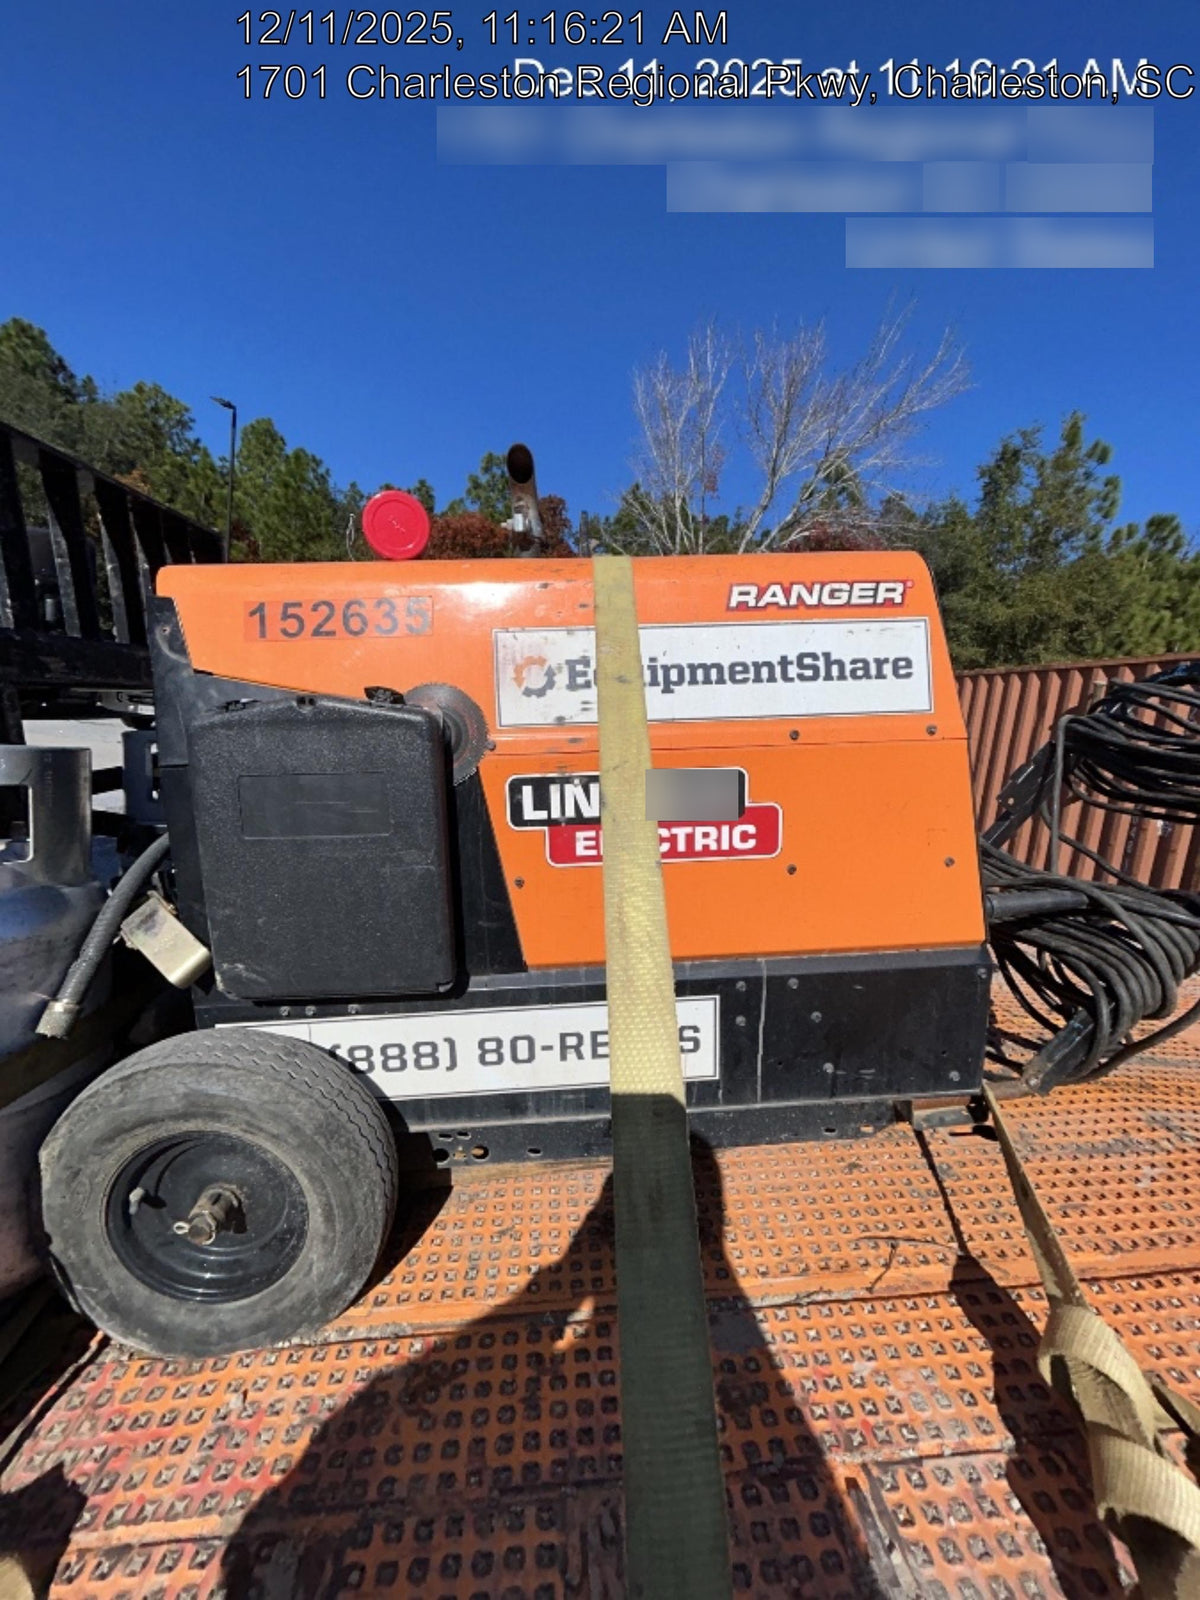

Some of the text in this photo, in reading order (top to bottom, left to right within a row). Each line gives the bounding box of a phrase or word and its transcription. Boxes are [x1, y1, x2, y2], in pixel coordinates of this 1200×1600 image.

[248, 597, 430, 638] 152635
[565, 651, 914, 694] EipmentShare
[477, 1025, 701, 1067] 80-RES
